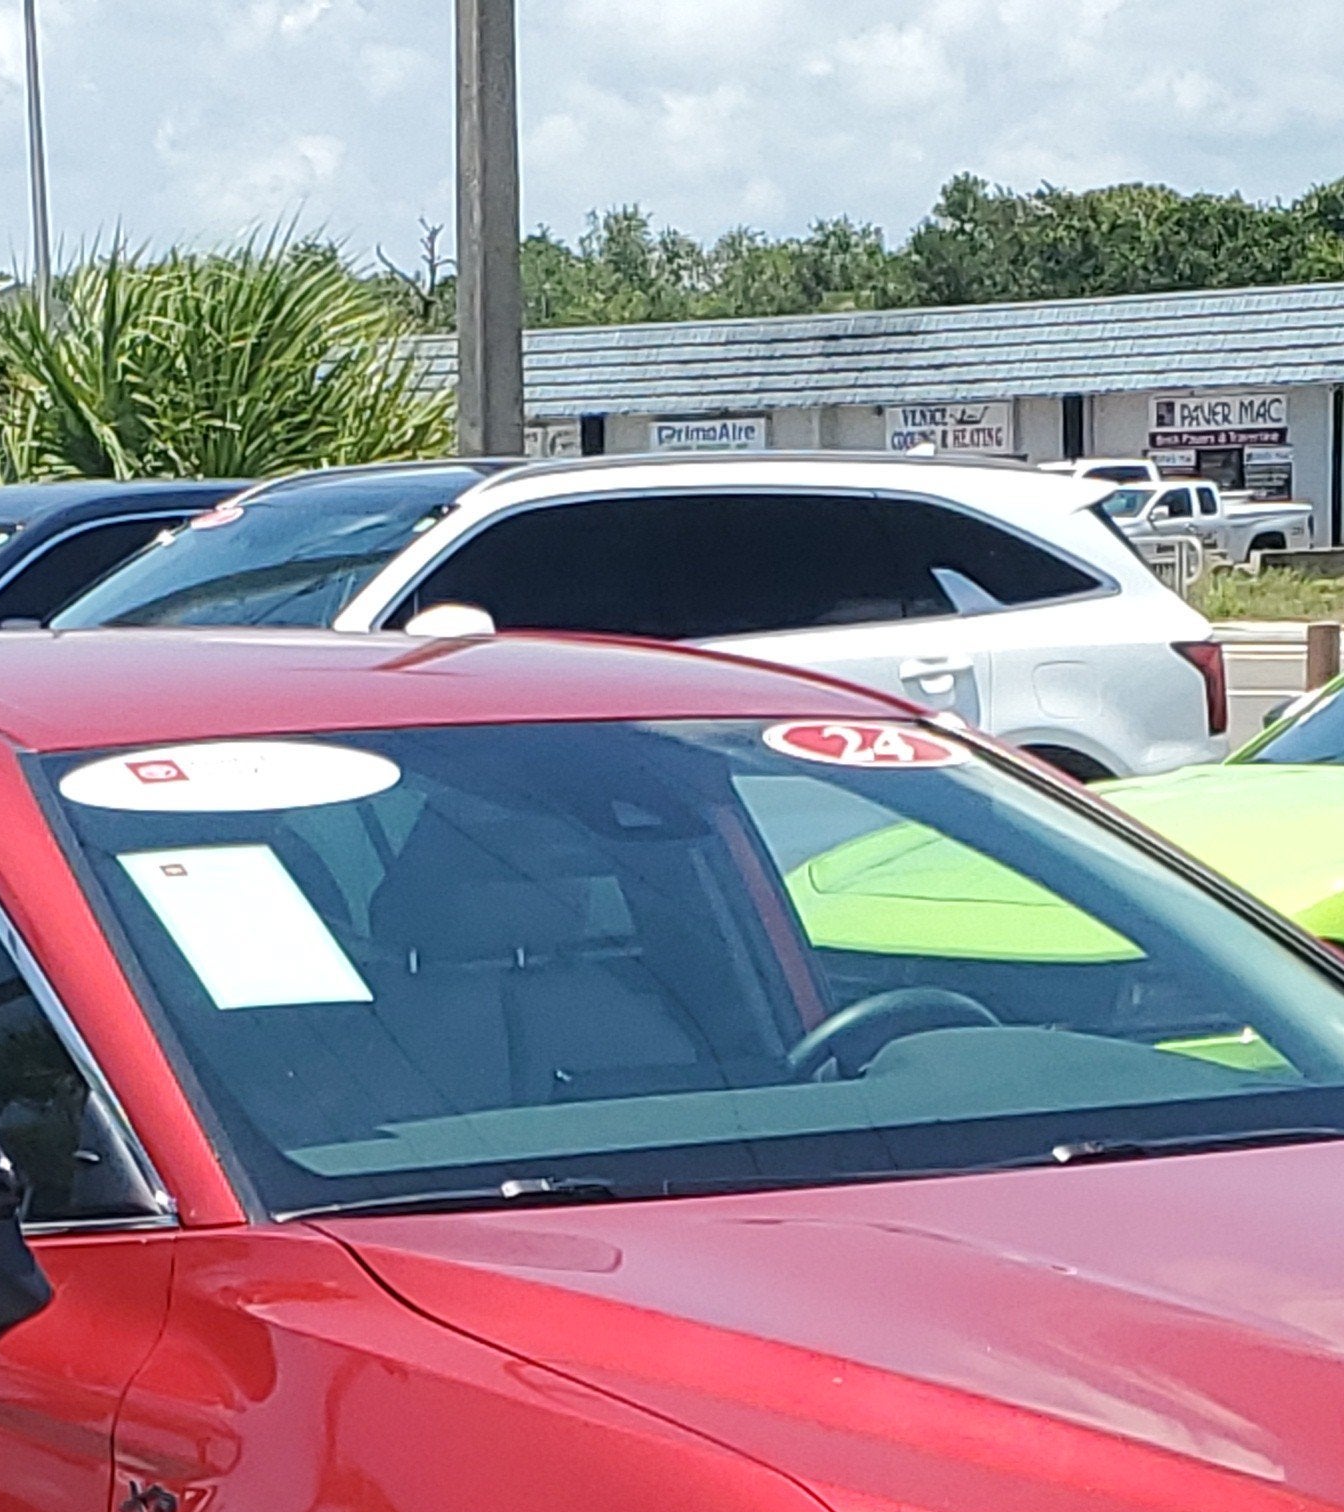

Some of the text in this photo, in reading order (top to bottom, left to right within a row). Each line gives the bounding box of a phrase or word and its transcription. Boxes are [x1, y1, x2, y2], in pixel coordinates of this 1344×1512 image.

[902, 406, 949, 427] VENICE
[1180, 397, 1284, 427] PAVER MAC
[952, 427, 1004, 448] HEATING
[821, 725, 915, 764] 24
